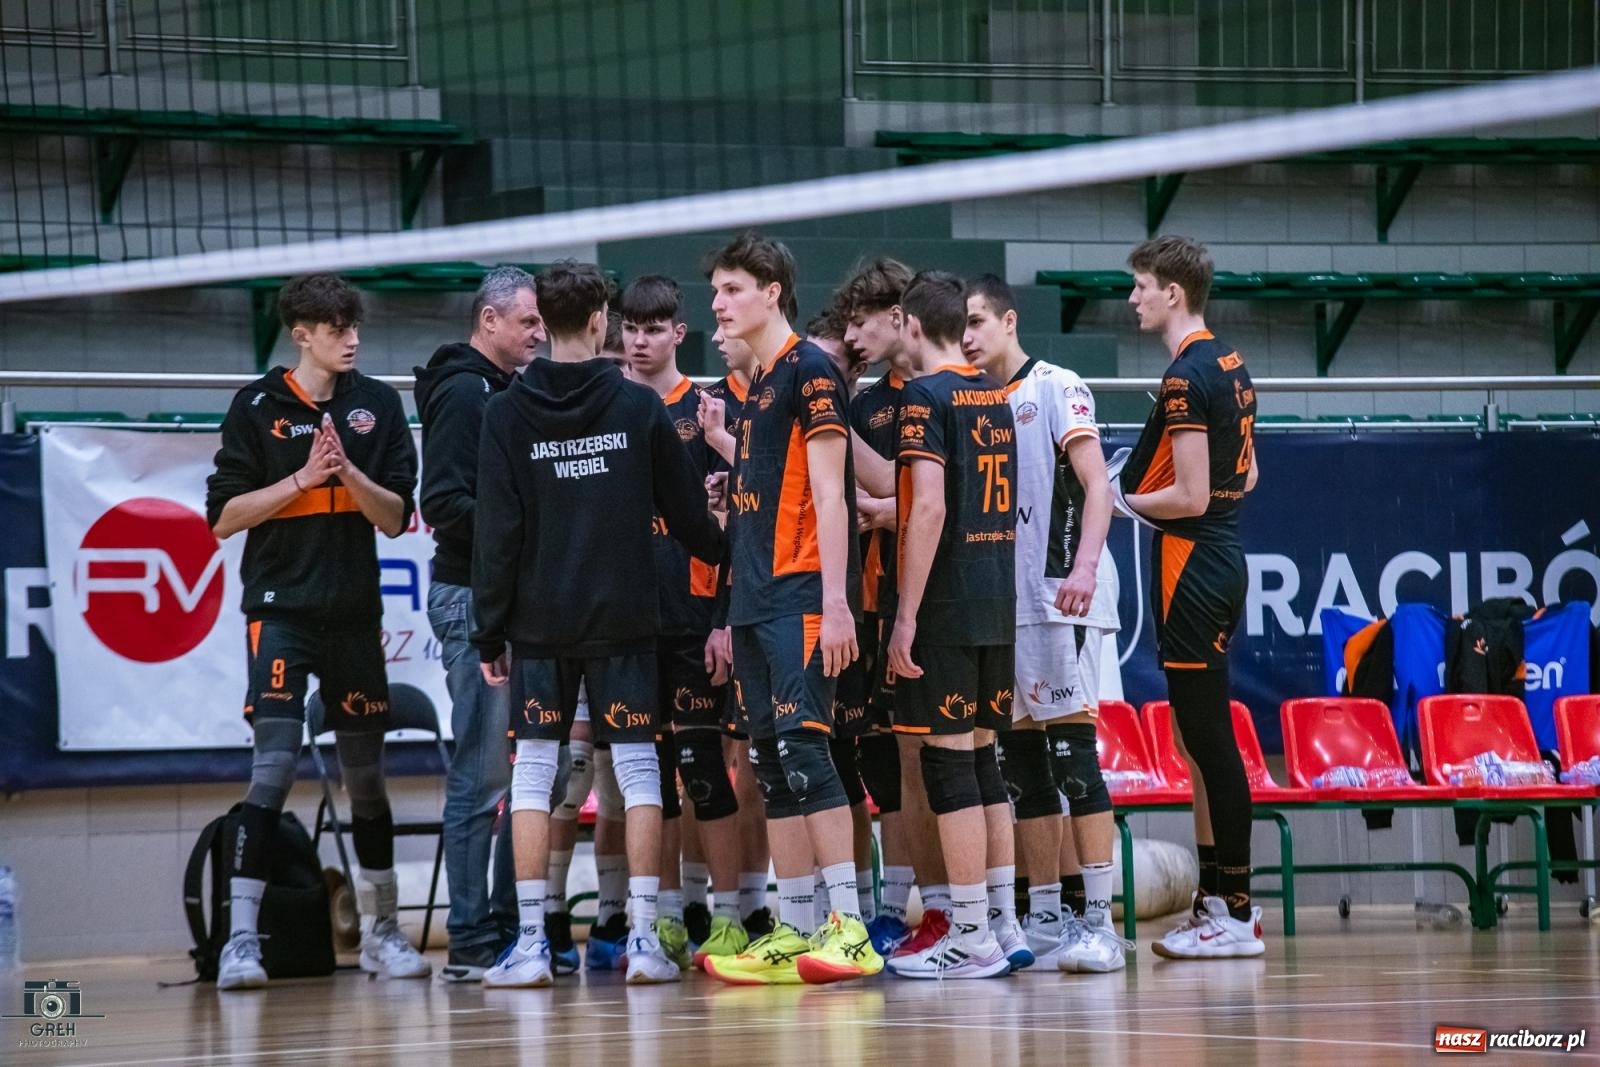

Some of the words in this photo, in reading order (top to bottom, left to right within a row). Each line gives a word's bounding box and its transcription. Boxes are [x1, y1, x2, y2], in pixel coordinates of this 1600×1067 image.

[530, 432, 628, 460] JASTRZĘBSKI
[990, 427, 1013, 447] JSW
[553, 456, 609, 480] WĘGIEL
[977, 453, 1010, 513] 75
[271, 658, 286, 689] 9
[1050, 686, 1074, 704] JSW
